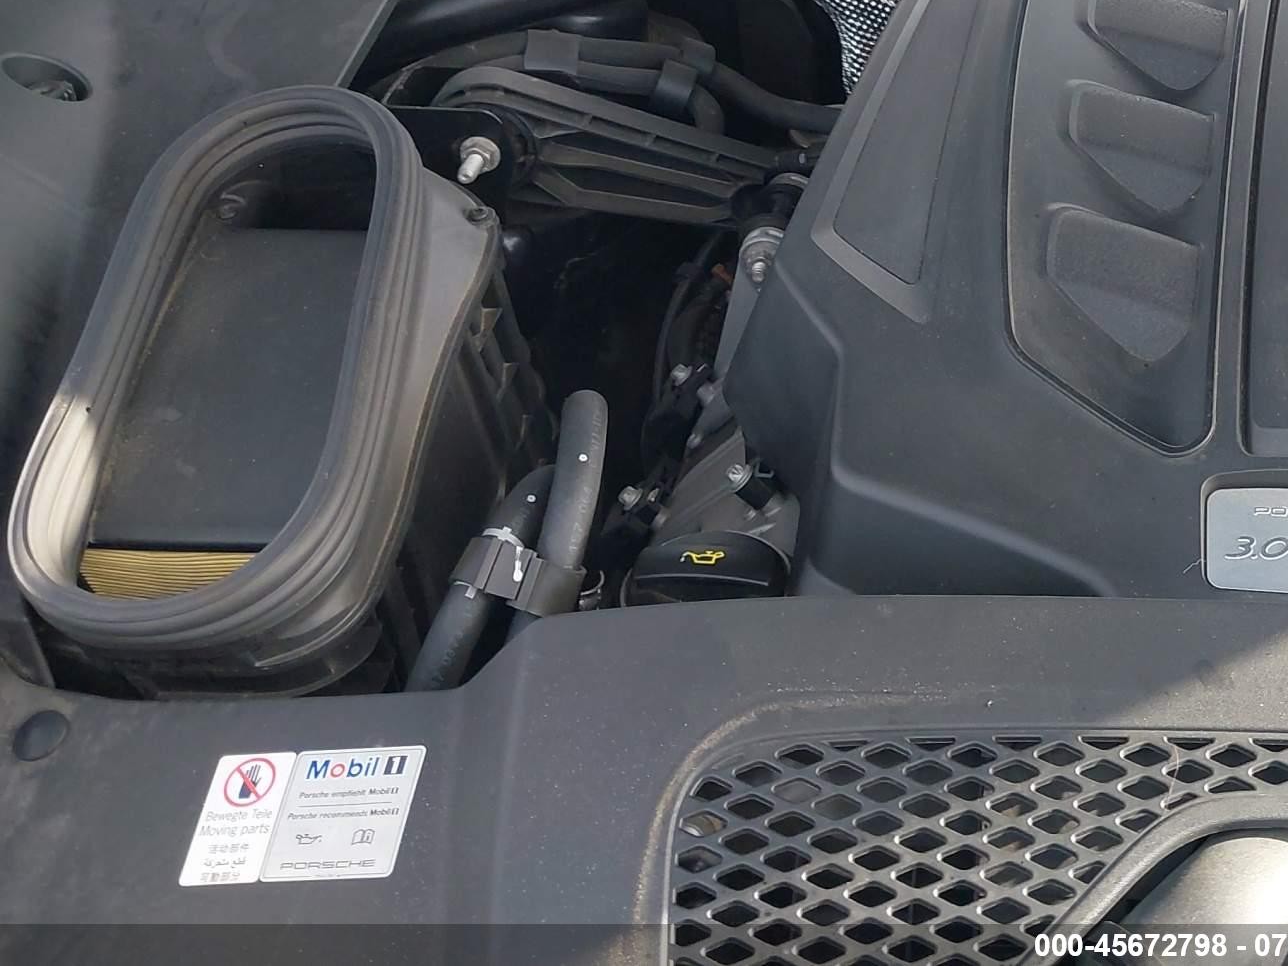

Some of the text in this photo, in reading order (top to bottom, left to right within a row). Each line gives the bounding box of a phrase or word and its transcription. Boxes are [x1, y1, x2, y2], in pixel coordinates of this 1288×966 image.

[305, 757, 380, 780] Mobil
[299, 791, 329, 799] Porsche
[205, 808, 273, 823] Bewegte Teile
[198, 824, 271, 837] Moving parts
[280, 859, 376, 870] PORSCHE
